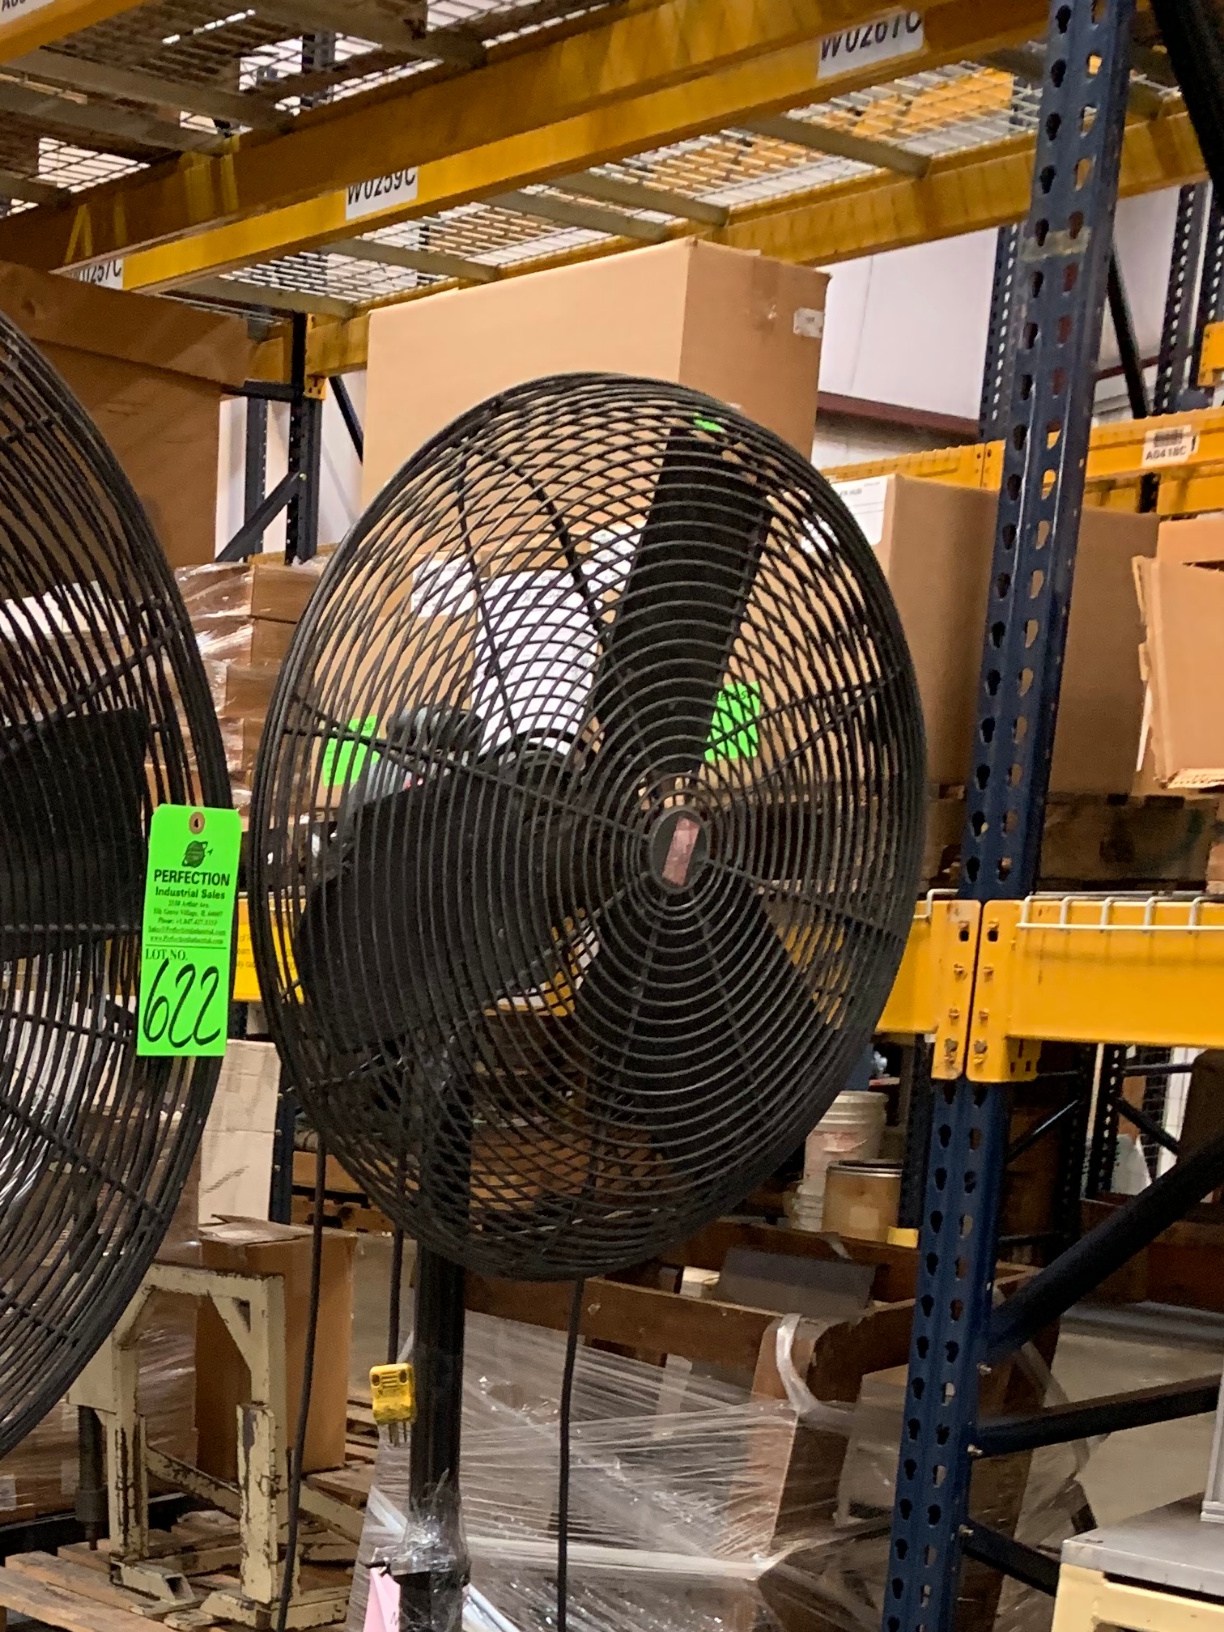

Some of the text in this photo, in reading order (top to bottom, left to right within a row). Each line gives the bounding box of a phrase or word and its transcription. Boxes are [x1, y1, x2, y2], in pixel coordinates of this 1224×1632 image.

[154, 869, 231, 887] PERFECTION
[155, 886, 225, 899] Industrial Sales
[145, 948, 188, 961] LOT NO.
[143, 957, 221, 1049] 622
